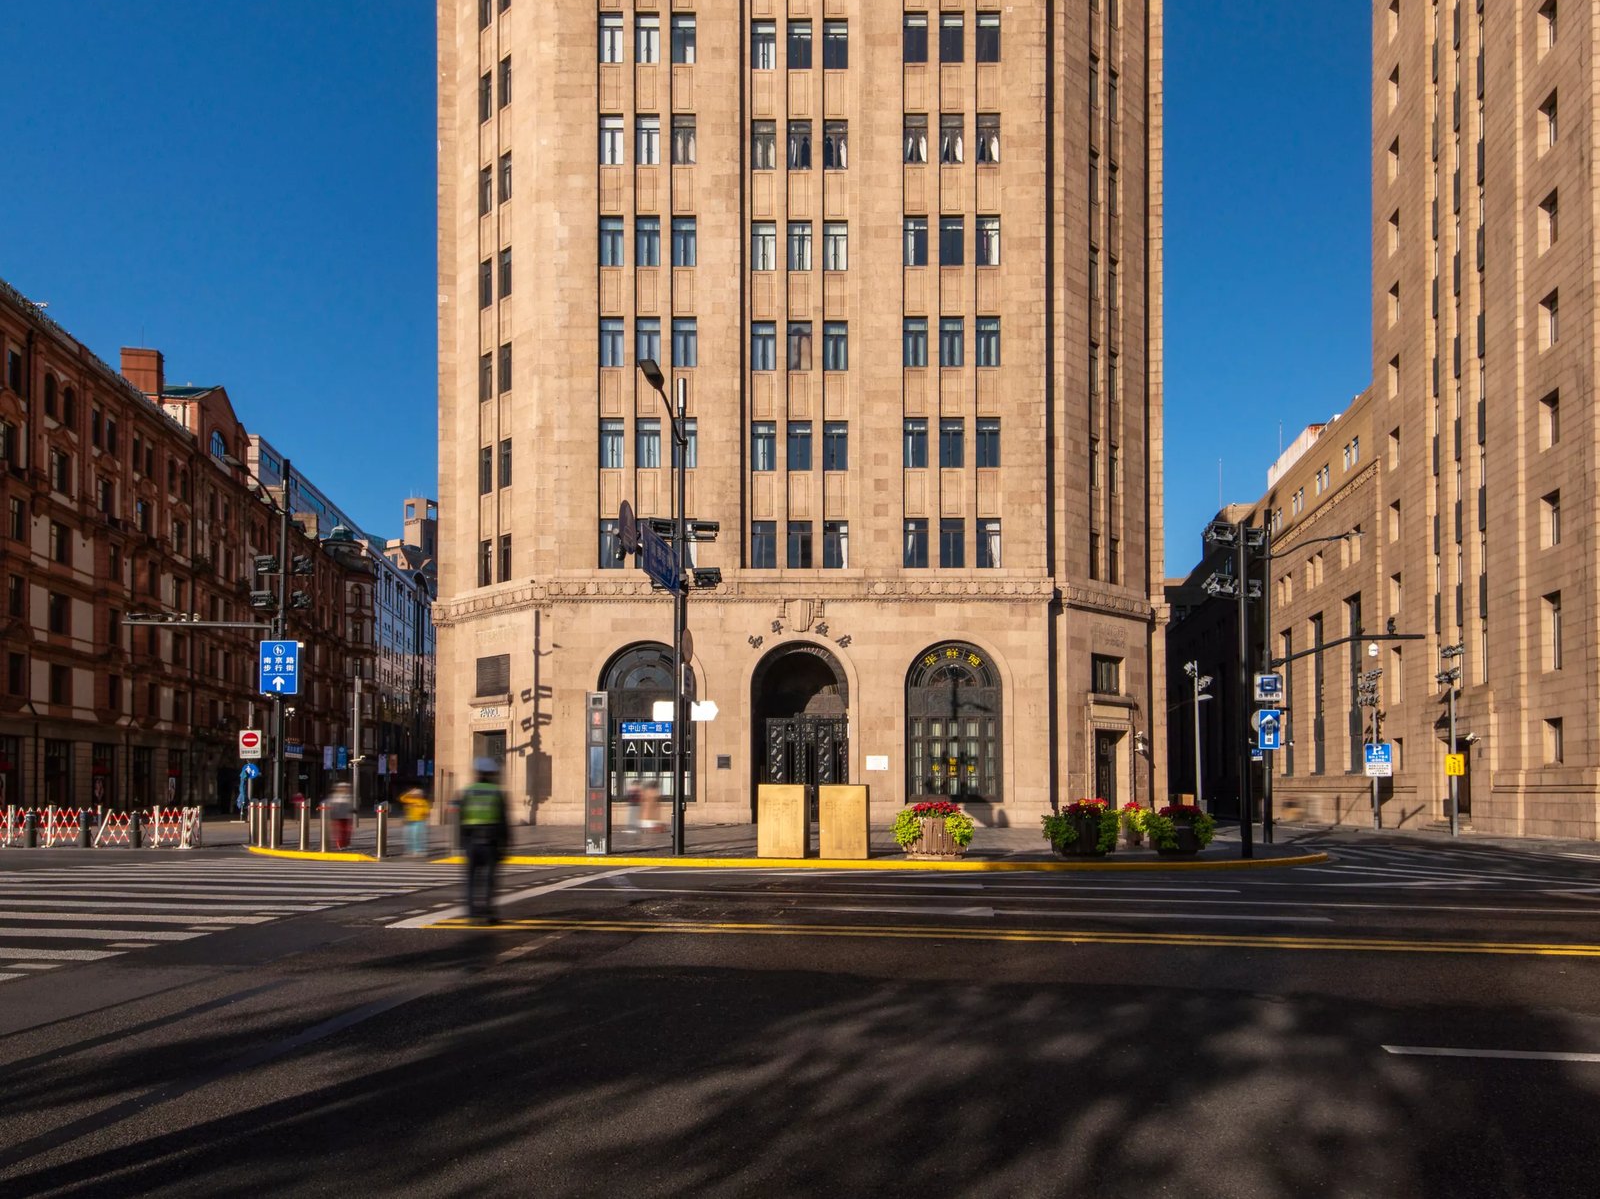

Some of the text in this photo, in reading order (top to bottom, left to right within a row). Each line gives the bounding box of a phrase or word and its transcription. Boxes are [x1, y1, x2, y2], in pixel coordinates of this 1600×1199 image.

[263, 656, 294, 664] 南京路
[263, 664, 294, 672] 步行街
[628, 724, 663, 732] 中山东一路
